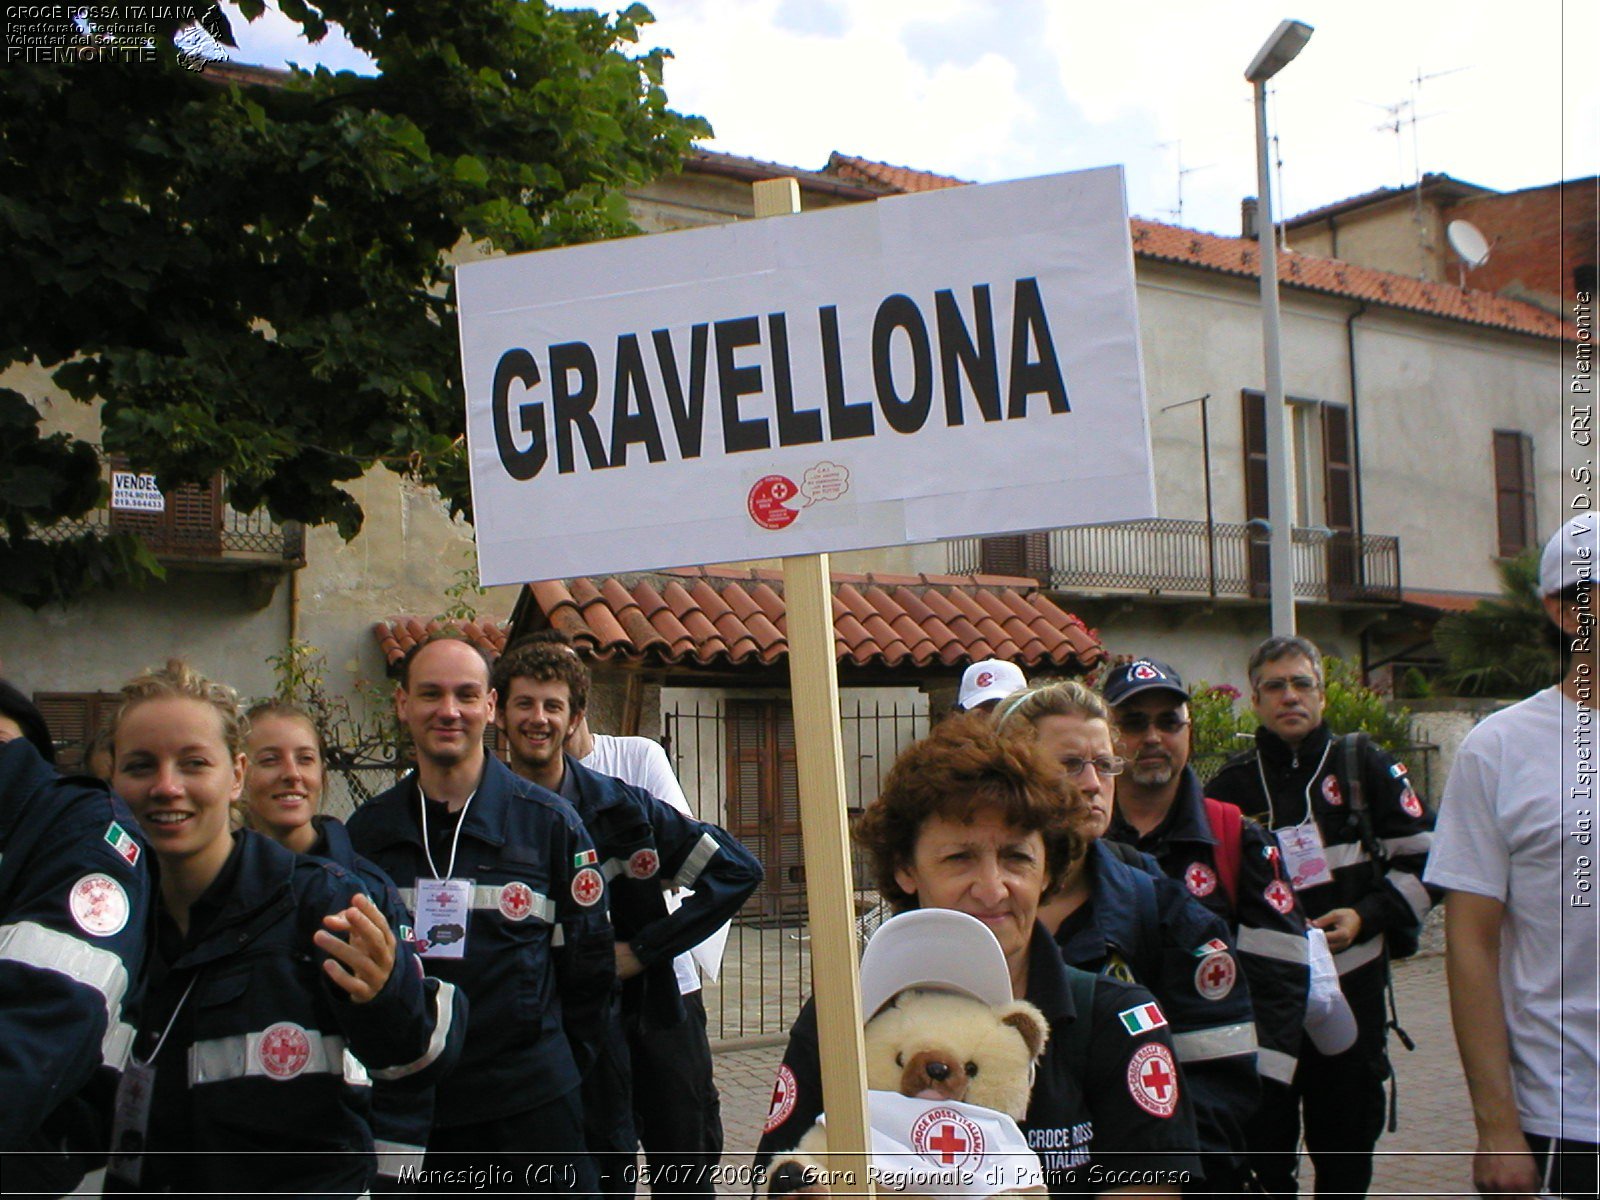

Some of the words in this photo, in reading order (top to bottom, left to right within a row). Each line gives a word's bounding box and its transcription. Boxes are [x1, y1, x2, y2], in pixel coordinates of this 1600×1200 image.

[491, 277, 1071, 481] GRAVELLONA
[928, 1110, 957, 1123] ROSSA
[1028, 1128, 1070, 1148] CROCE
